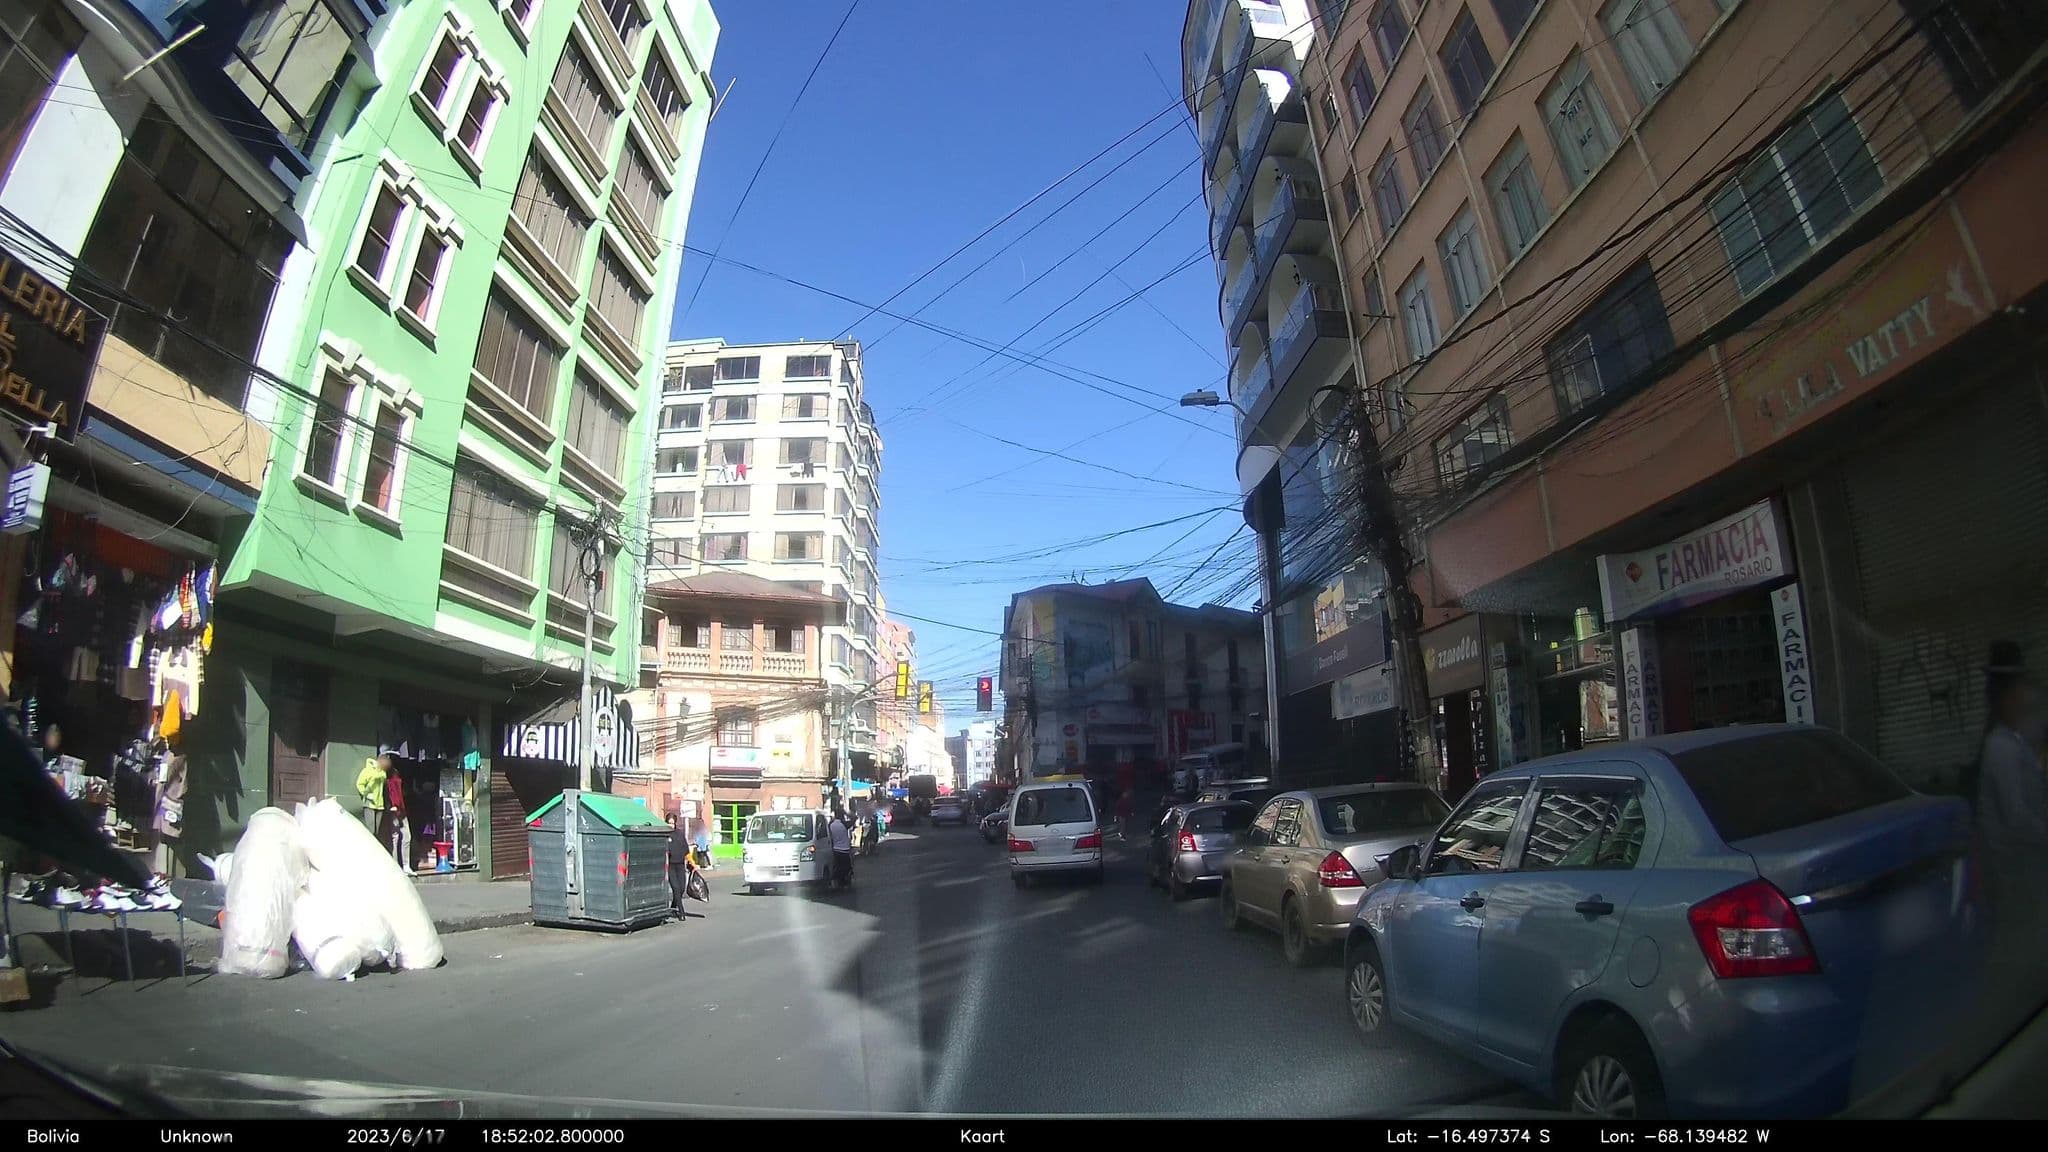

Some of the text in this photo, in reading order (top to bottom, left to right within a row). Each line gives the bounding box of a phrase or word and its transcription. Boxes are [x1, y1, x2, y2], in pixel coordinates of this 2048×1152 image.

[1846, 296, 1936, 378] VATTY
[1655, 516, 1769, 590] FARMACIA
[1723, 556, 1773, 585] ROSARIO
[1781, 612, 1806, 724] FARMACI
